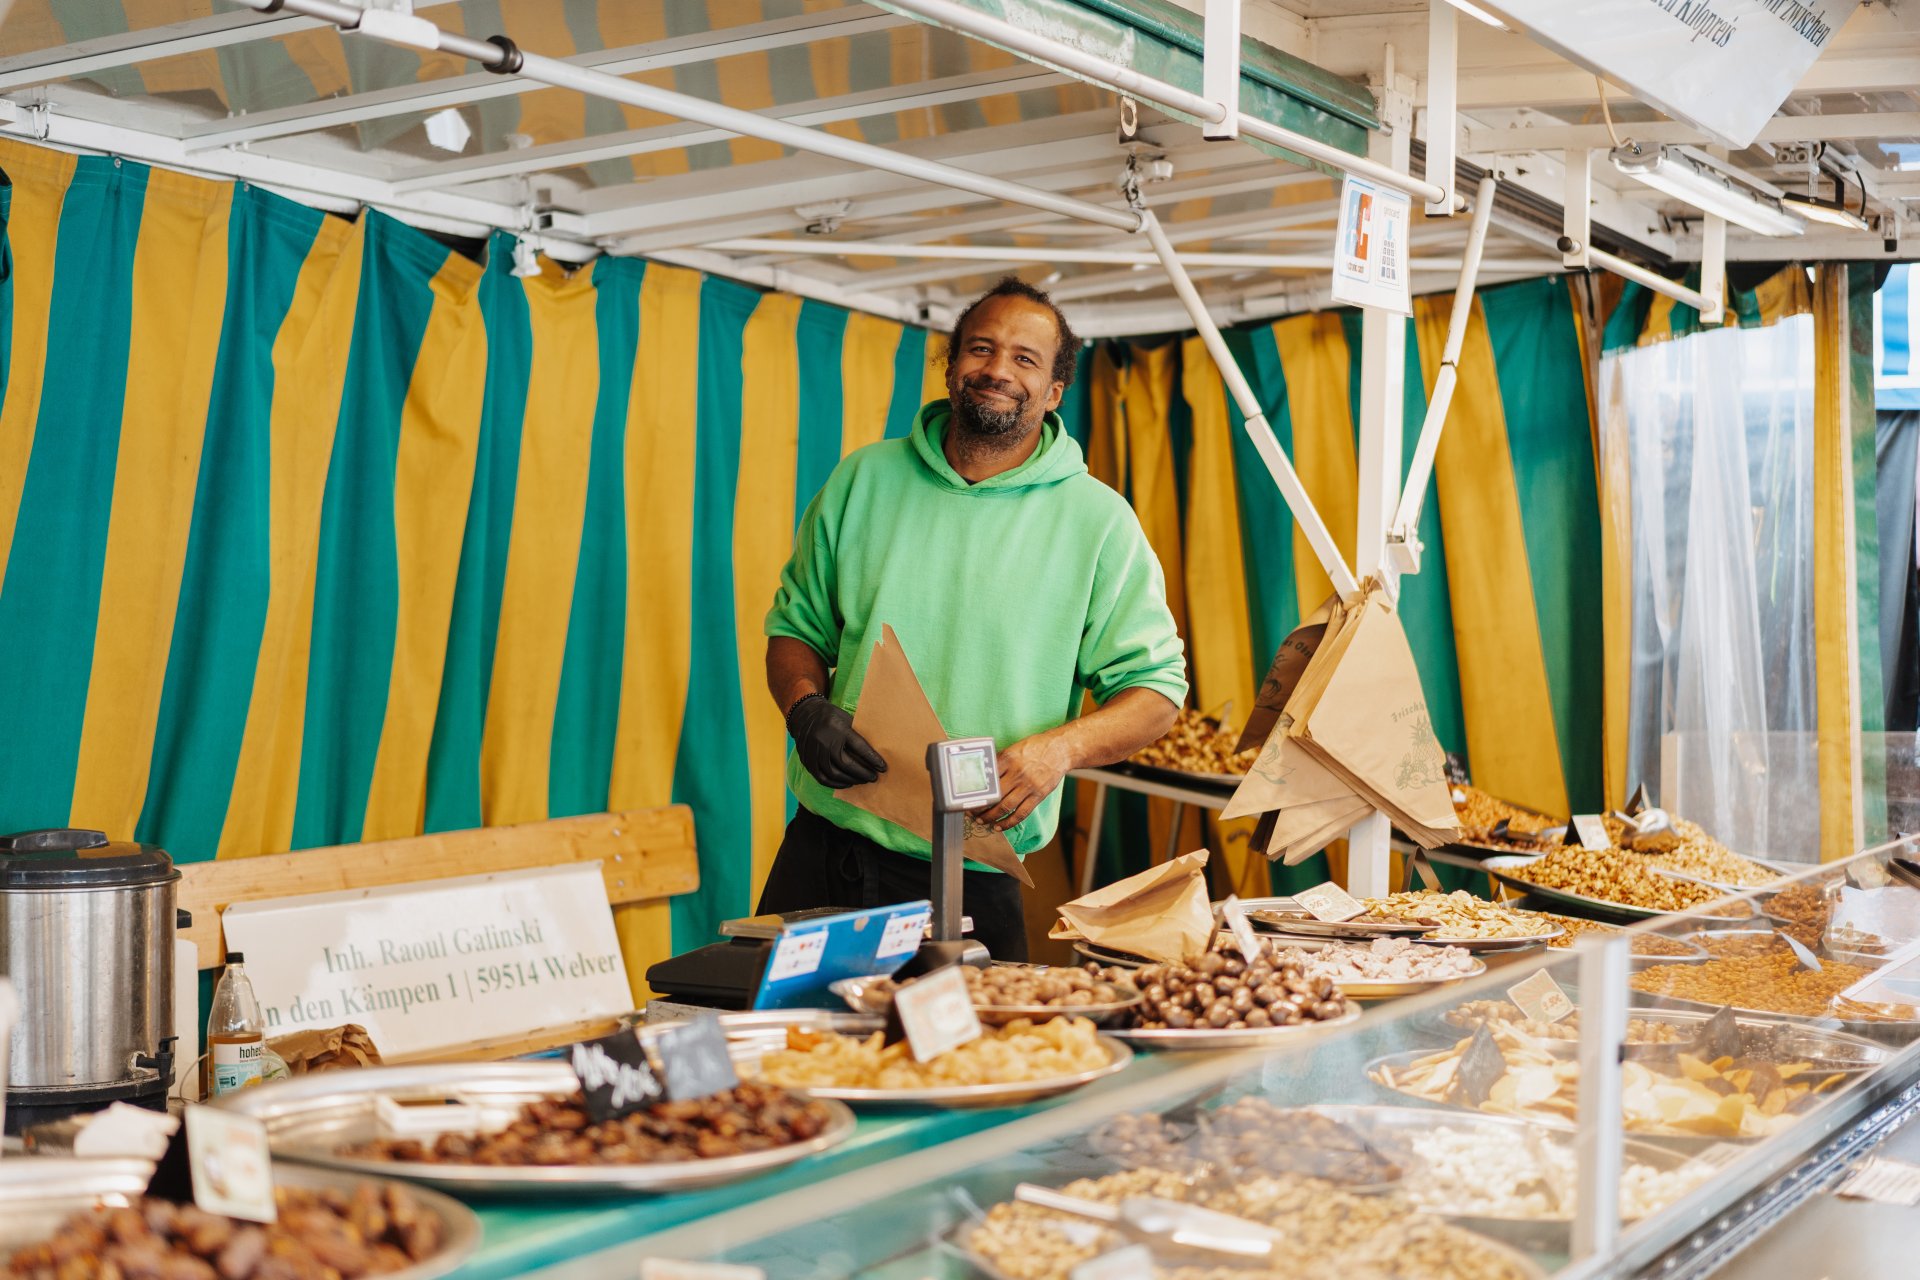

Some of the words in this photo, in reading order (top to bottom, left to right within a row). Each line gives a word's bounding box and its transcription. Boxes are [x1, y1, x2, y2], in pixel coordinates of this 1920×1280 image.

[1779, 0, 1831, 48] zwischen
[322, 943, 373, 973] Inh.
[378, 931, 448, 966] Raoul
[453, 918, 544, 955] Galinski
[290, 994, 335, 1024] den
[339, 981, 440, 1015] Kämpen
[447, 973, 458, 999] 1
[477, 959, 540, 994] 59514
[543, 951, 617, 981] Welver
